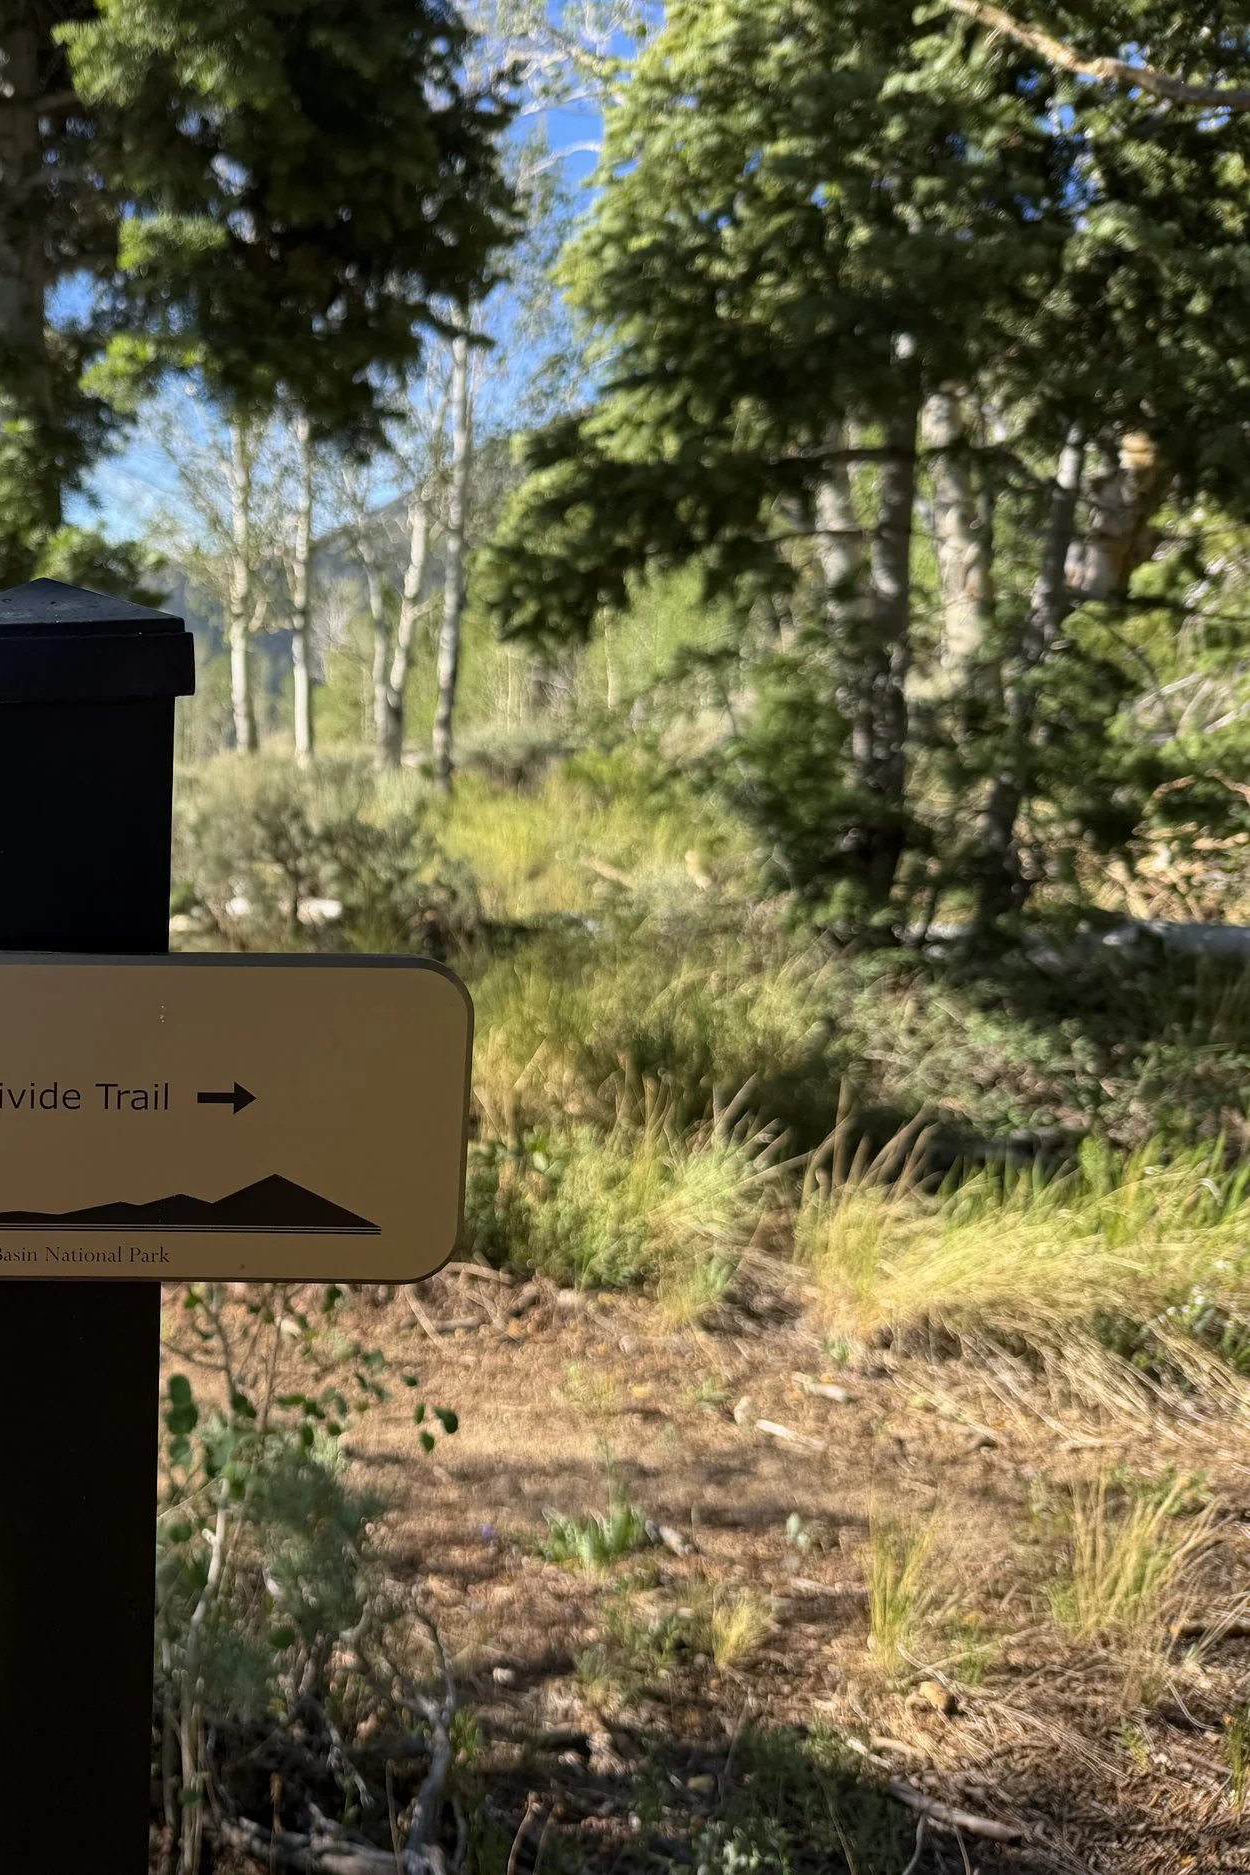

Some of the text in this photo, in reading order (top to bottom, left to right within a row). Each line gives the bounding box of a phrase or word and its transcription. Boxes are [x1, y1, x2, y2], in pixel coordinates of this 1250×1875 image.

[94, 1082, 170, 1111] Trail
[45, 1246, 122, 1263] National
[129, 1246, 170, 1264] Park
